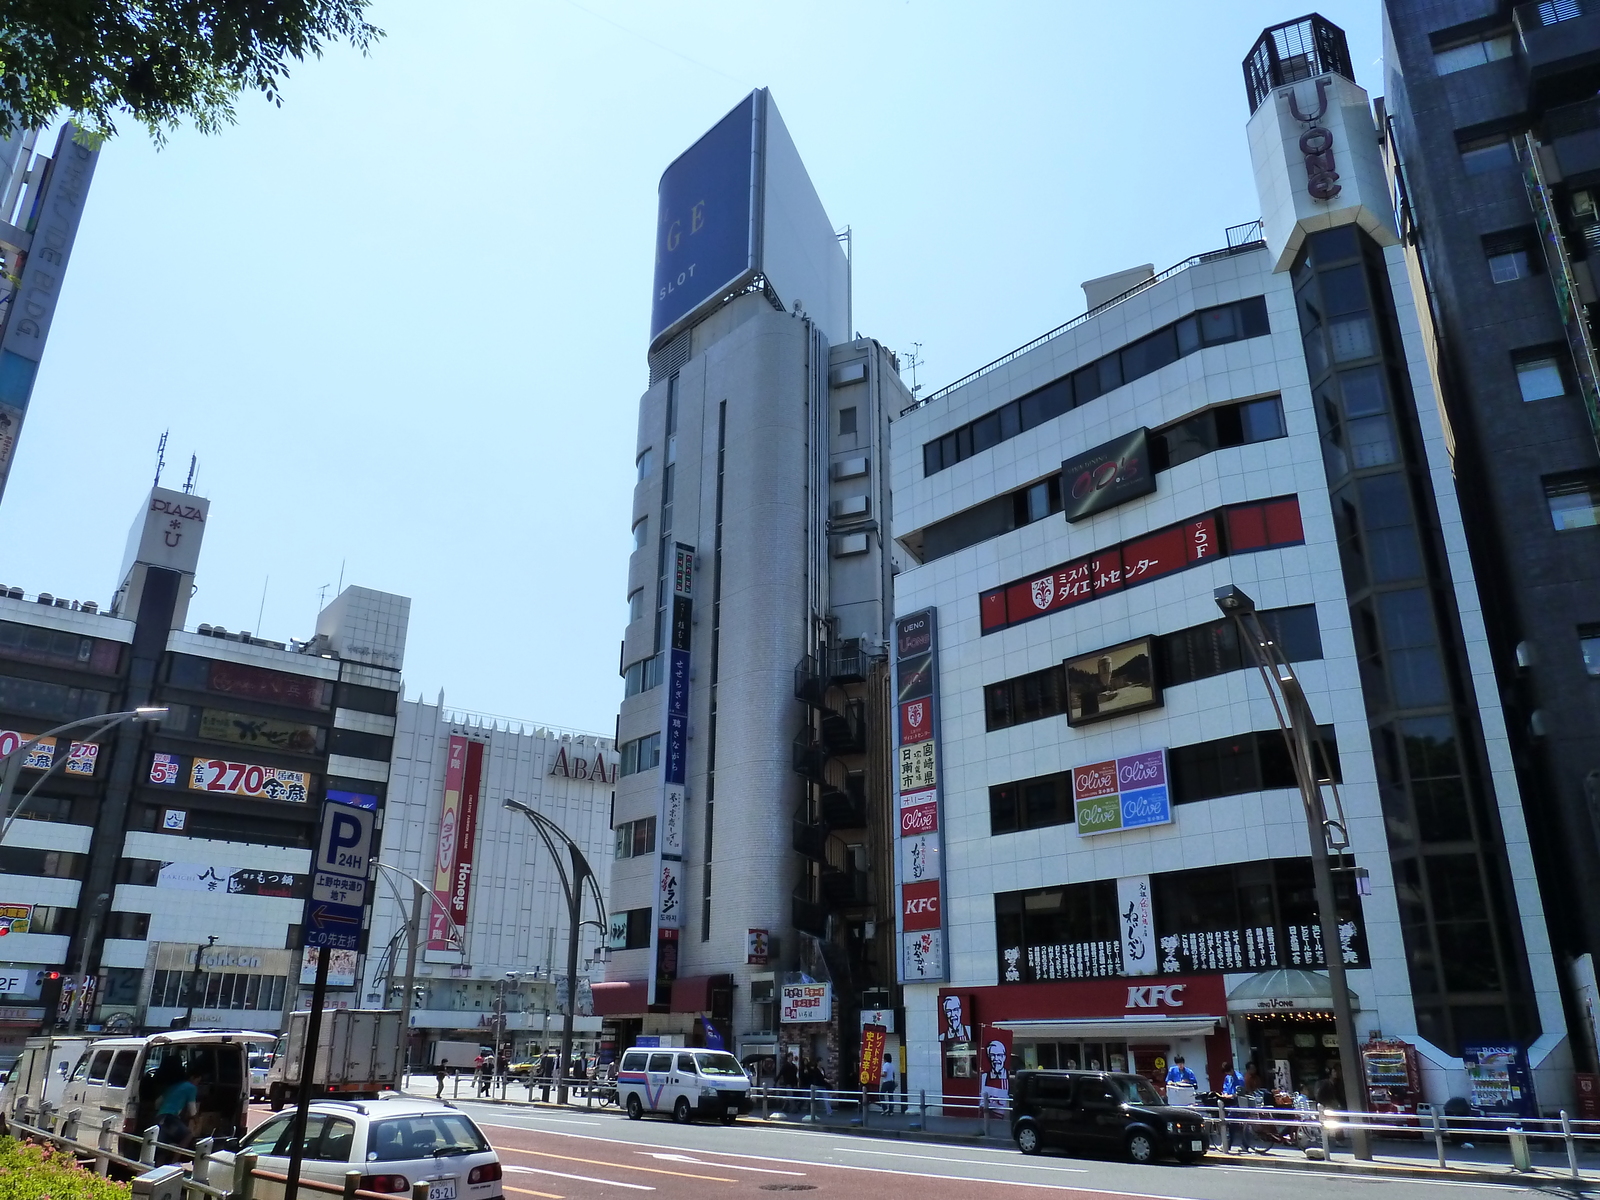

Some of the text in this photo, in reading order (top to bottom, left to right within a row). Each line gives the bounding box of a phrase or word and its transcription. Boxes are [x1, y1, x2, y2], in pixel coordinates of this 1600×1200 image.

[659, 263, 697, 301] SLOT
[151, 499, 204, 522] PLAZA
[164, 530, 182, 547] U
[676, 552, 684, 591] ITALIA
[685, 555, 693, 594] CUCINA
[1058, 561, 1101, 585] ミスパリ
[1058, 558, 1159, 601] ダイエットセンター
[903, 620, 924, 633] UENO
[675, 660, 684, 710] せせらぎを
[450, 743, 463, 770] 7階
[671, 719, 682, 772] 聴きながら
[194, 764, 204, 785] 全品
[902, 748, 914, 788] 日南市
[923, 743, 935, 785] 宮崎県
[1119, 760, 1158, 784] Olive
[277, 769, 304, 783] 居酒屋
[1076, 769, 1112, 792] Olive
[262, 777, 307, 802] 金の蔵
[903, 792, 934, 806] オリーブ
[1079, 804, 1115, 827] Olive
[1123, 796, 1162, 819] Olive
[902, 809, 932, 830] Olive
[327, 811, 362, 864] P
[441, 823, 454, 861] ダイソー
[338, 852, 362, 869] 24H
[256, 871, 295, 886] もつ鍋
[316, 875, 363, 893] 上野中央通り
[453, 863, 471, 911] Honeys
[330, 890, 347, 901] 地下
[662, 876, 679, 914] トラジ
[905, 897, 937, 914] KFC
[660, 914, 677, 922] 도라지
[308, 930, 357, 948] この先左折
[793, 998, 820, 1008] しゃぶしゃぶ
[804, 986, 825, 997] ステーキ
[1125, 985, 1184, 1008] KFC
[305, 999, 348, 1009] 50円券
[862, 1031, 875, 1071] 史上最辛
[871, 1032, 883, 1081] レッドホット
[1477, 1091, 1498, 1099] BOSS
[429, 1187, 454, 1199] 69-21
